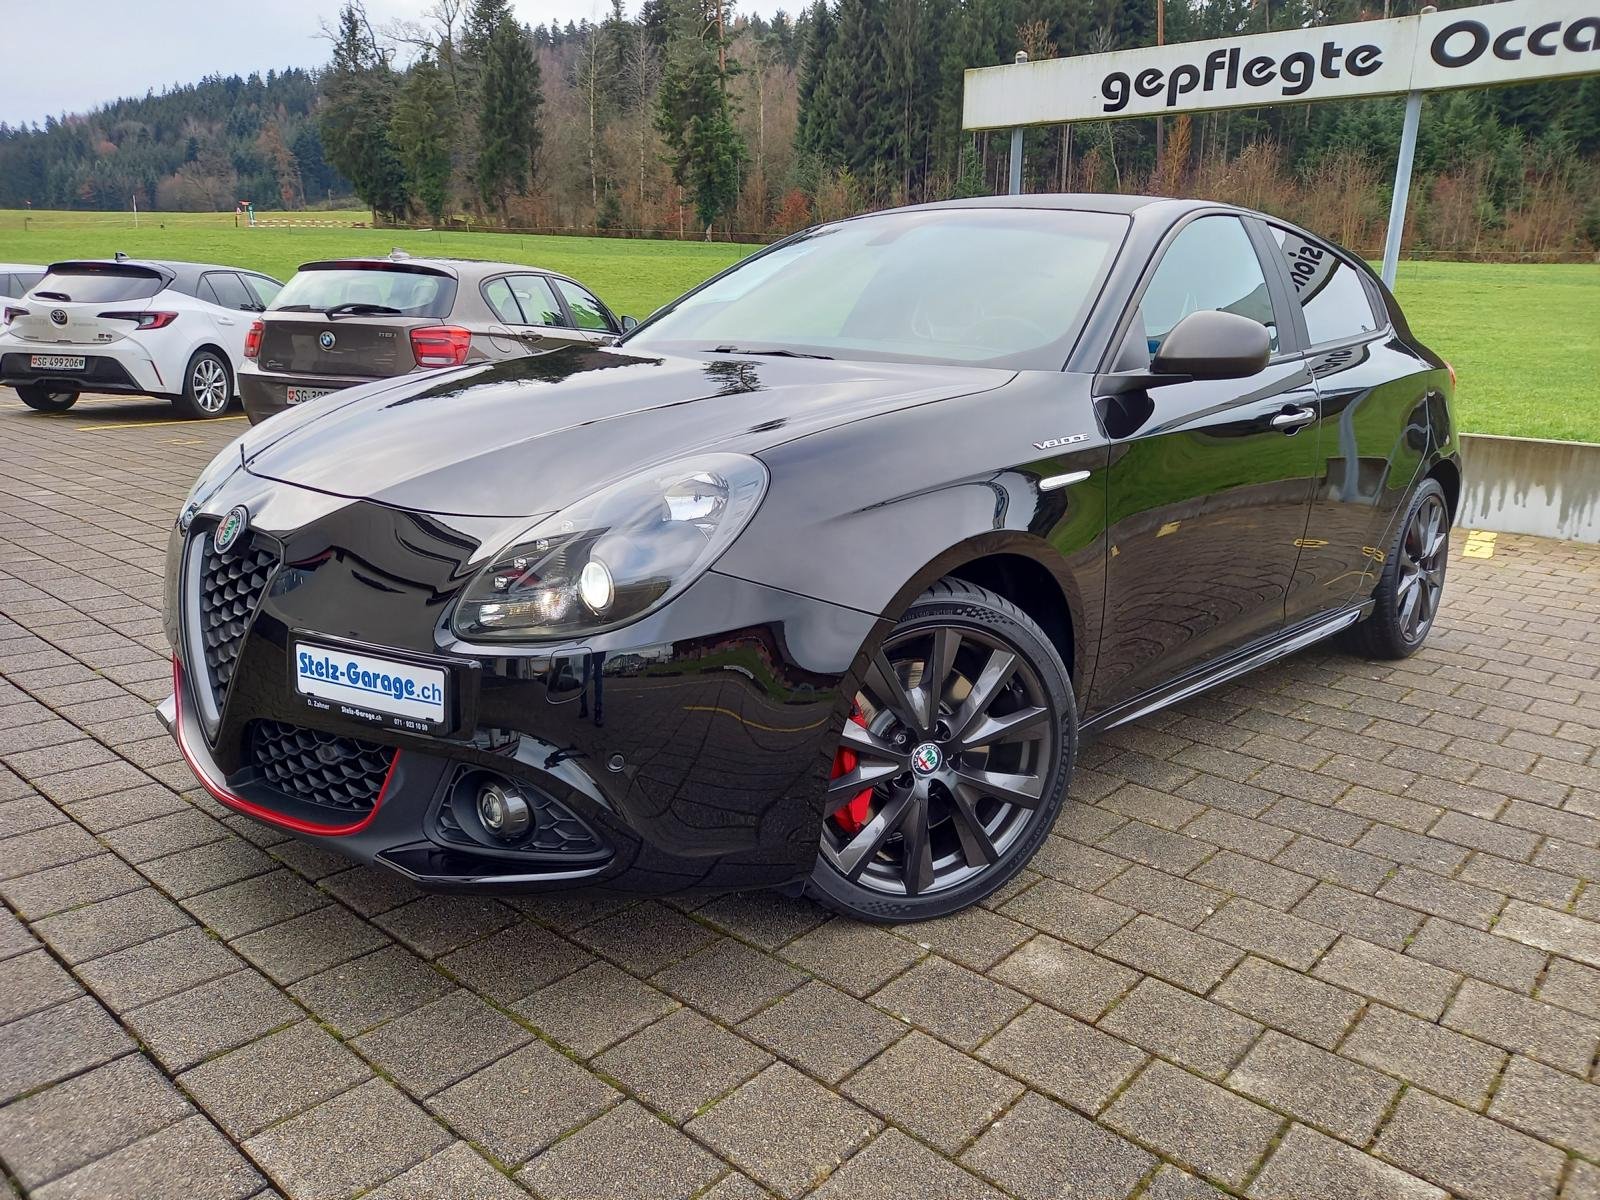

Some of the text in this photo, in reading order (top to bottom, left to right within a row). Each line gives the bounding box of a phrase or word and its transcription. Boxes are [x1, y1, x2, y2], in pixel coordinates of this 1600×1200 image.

[1101, 16, 1600, 112] gepflegte Occa
[37, 357, 47, 366] SG
[295, 389, 308, 402] SG
[1032, 433, 1090, 450] VELOCE
[300, 652, 442, 701] Stelz-Garage.ch
[341, 706, 383, 721] Stelz-Garage.ch
[1049, 735, 1069, 810] MICHELIN
